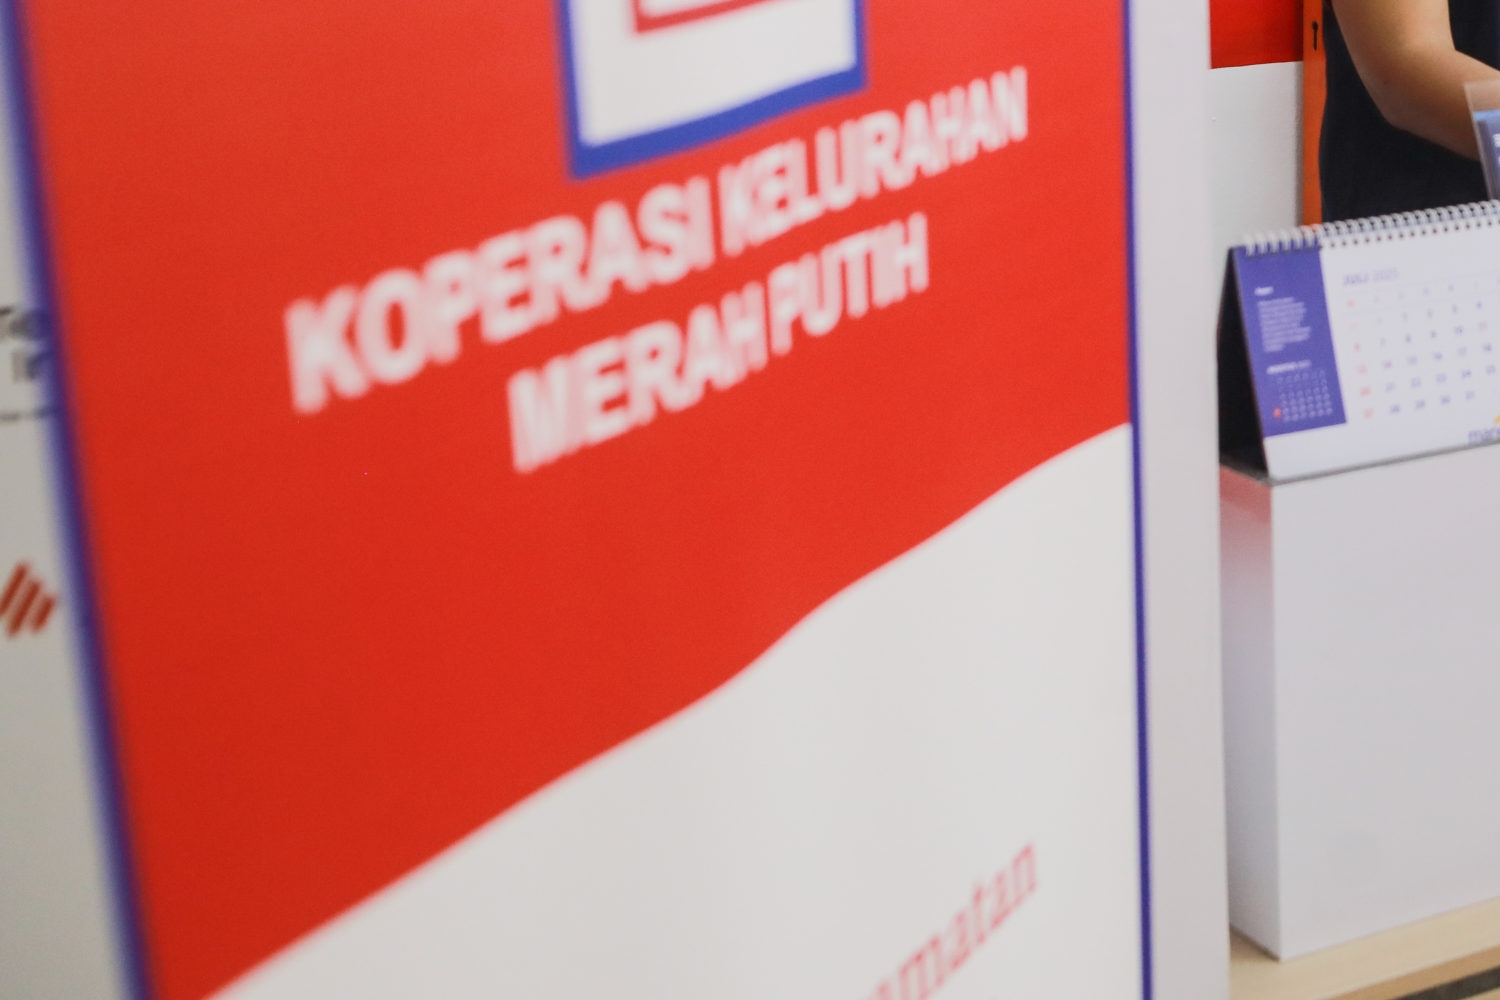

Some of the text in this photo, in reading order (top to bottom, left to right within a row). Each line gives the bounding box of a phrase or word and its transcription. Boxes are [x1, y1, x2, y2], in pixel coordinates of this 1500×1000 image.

[284, 175, 717, 415] KOPERASI
[718, 65, 1029, 257] KELURAHAN
[506, 212, 929, 475] MERAH PUTIH
